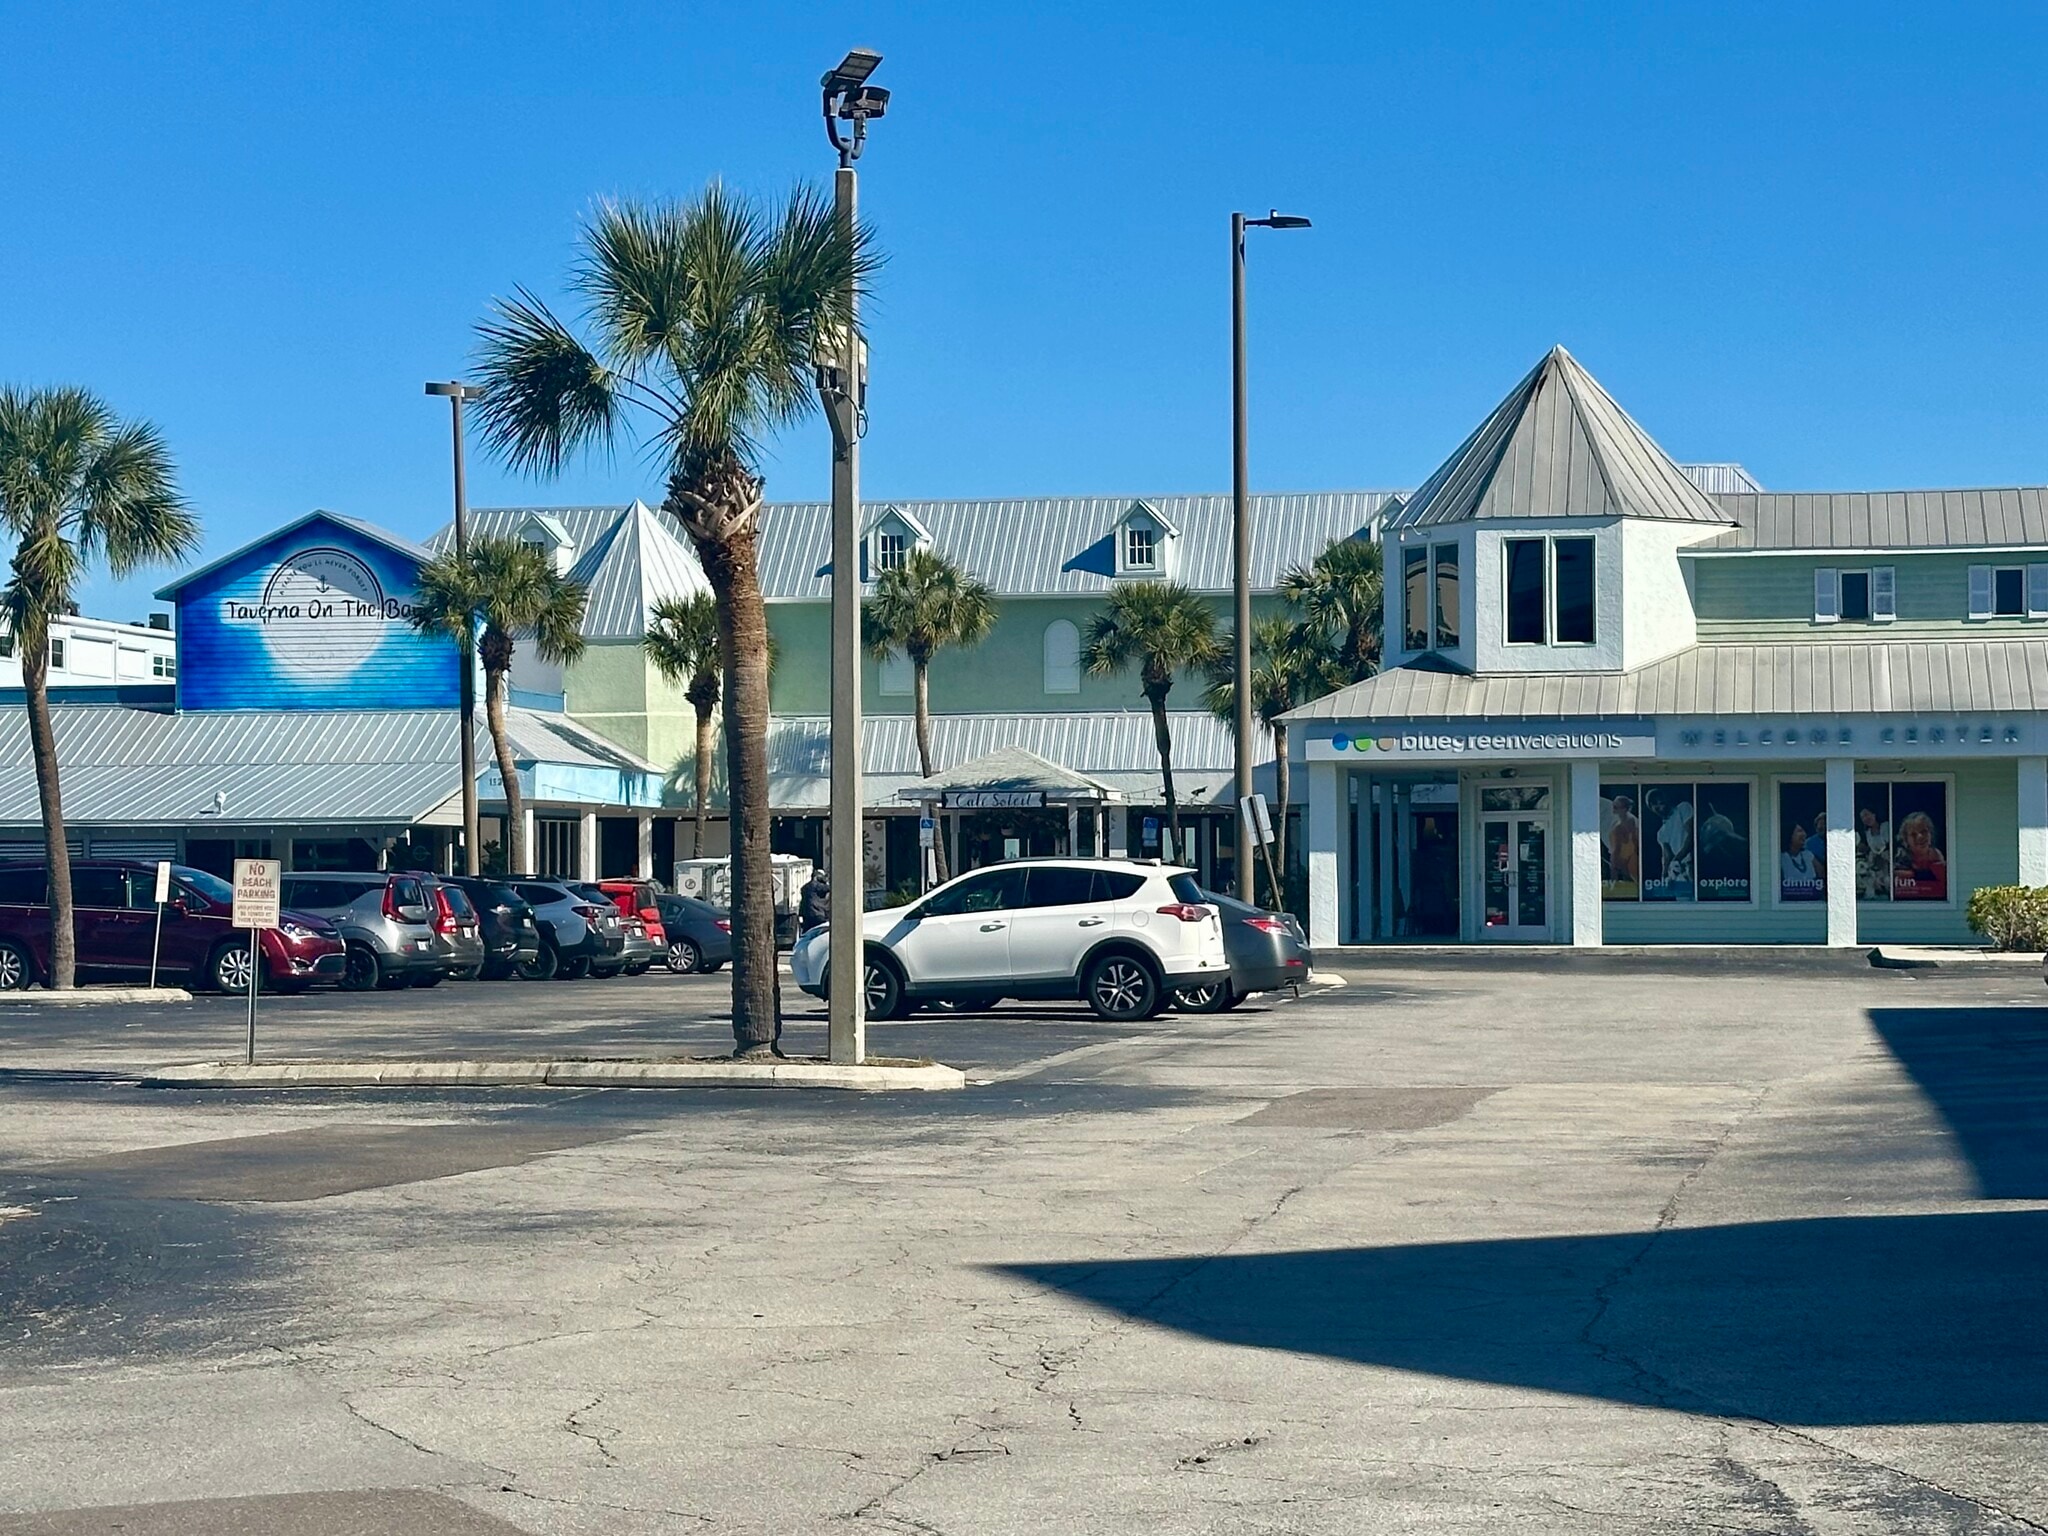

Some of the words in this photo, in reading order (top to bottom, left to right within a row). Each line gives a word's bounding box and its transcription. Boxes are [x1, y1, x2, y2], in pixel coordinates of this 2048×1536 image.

[225, 601, 300, 620] Taverna
[308, 599, 334, 619] On
[341, 599, 375, 618] The
[1401, 731, 1623, 753] bluegreenvacations
[1679, 728, 1852, 746] WELCOME
[1880, 726, 2019, 744] CENTER
[249, 864, 265, 875] NO
[242, 877, 272, 886] BEACH
[1644, 877, 1669, 890] golf
[1699, 877, 1748, 890] explore
[1782, 876, 1825, 890] dining
[1894, 876, 1916, 887] fun
[237, 889, 275, 898] PARKING
